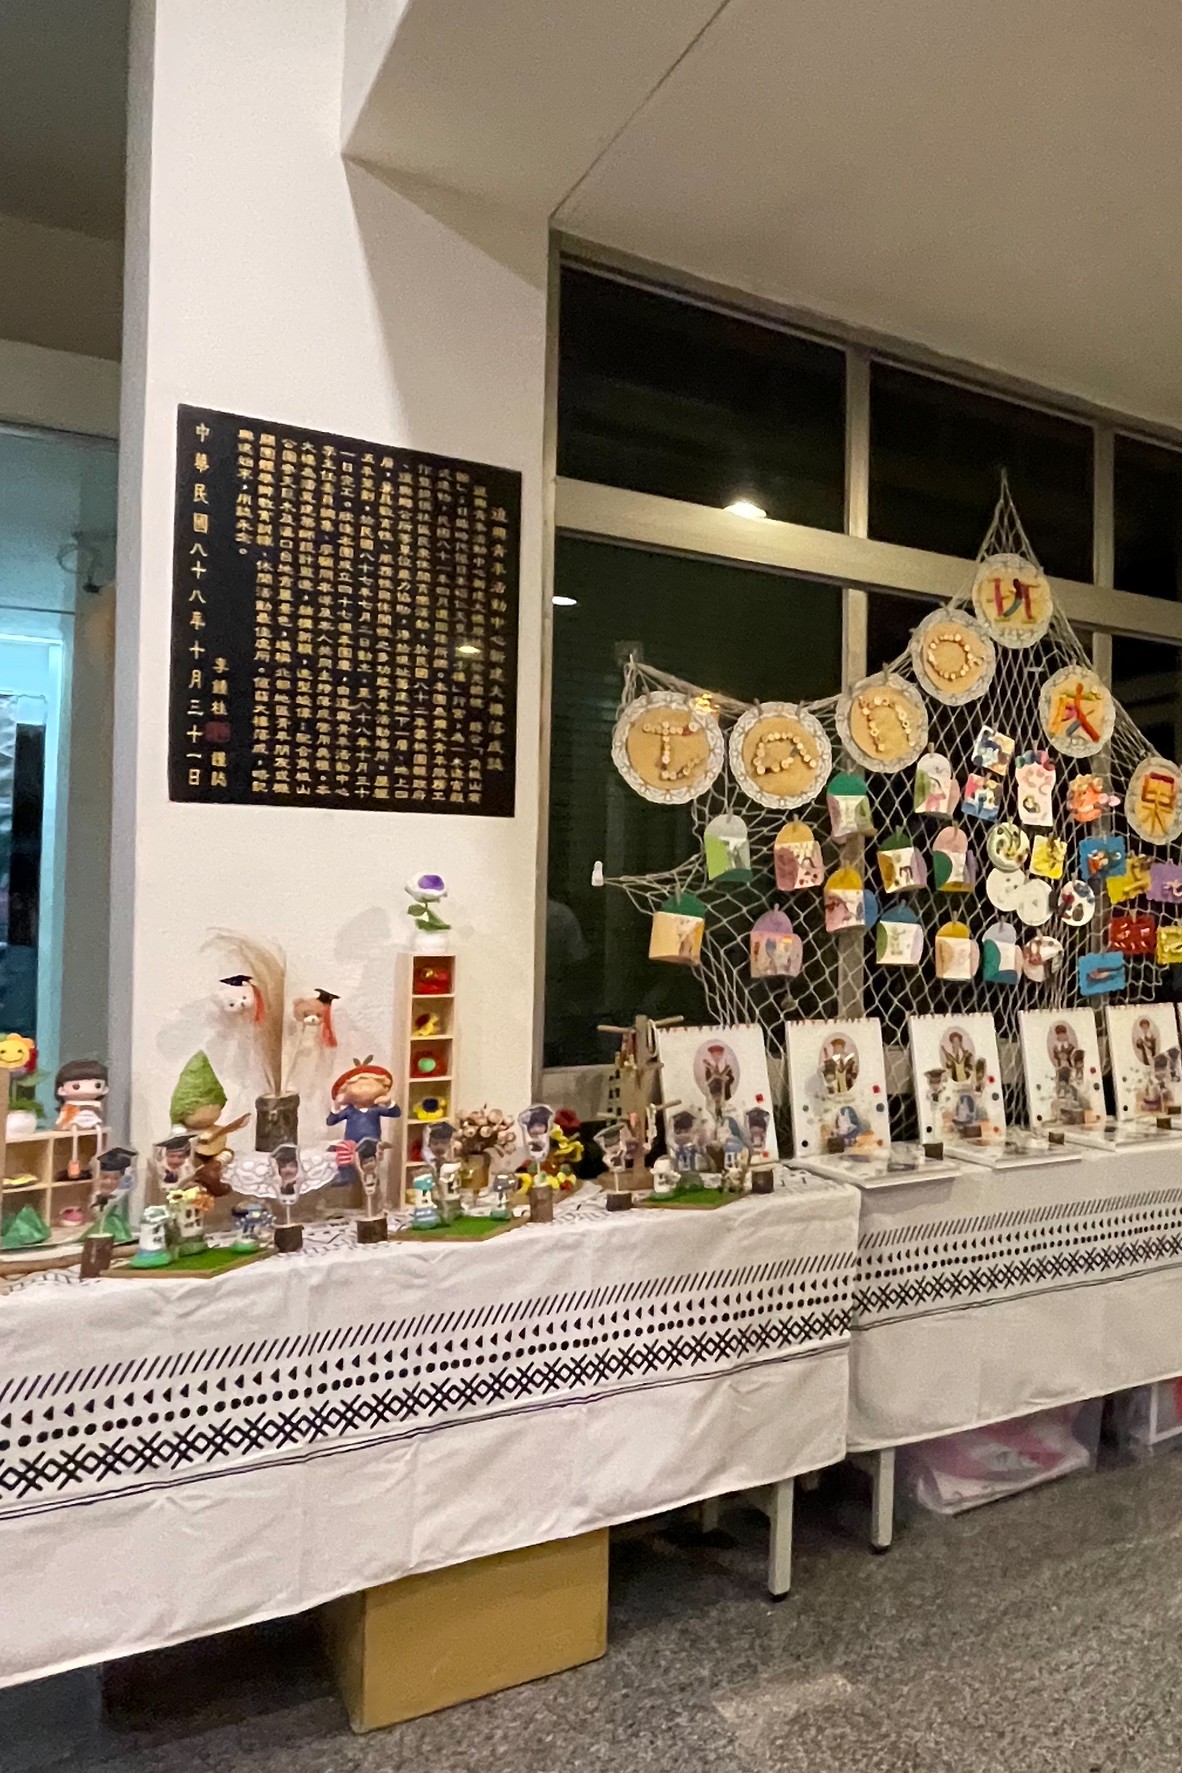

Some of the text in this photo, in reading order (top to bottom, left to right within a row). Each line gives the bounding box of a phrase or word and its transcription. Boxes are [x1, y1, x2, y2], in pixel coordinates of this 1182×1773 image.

[184, 422, 210, 786] 中華民國八十八年十月三十一日
